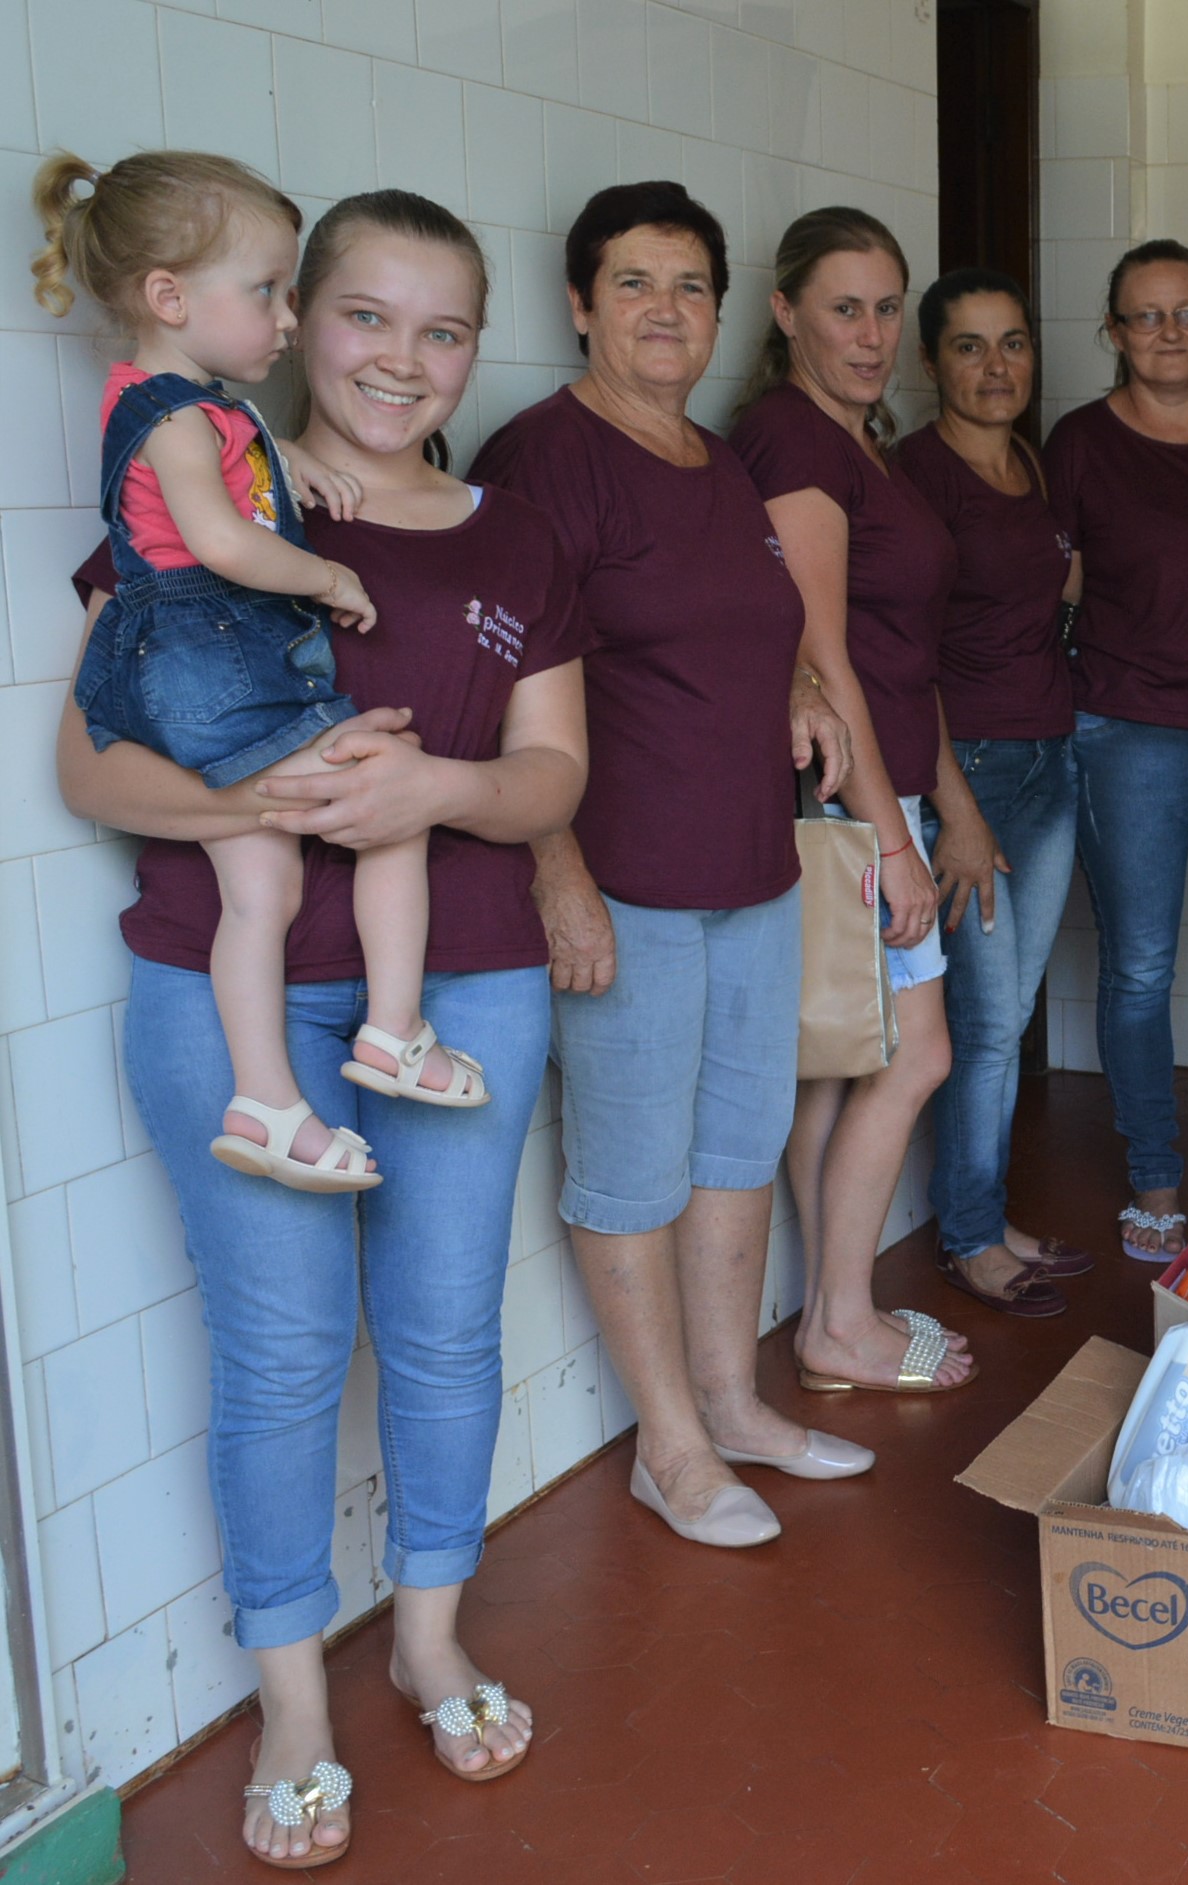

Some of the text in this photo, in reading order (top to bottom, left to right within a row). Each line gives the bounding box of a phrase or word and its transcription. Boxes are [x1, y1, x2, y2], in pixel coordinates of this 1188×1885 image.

[495, 604, 525, 634] Núcleo
[1051, 1525, 1104, 1540] MANTENHA
[1107, 1533, 1159, 1548] RESFRIADO
[1087, 1583, 1178, 1626] Becel
[1128, 1706, 1162, 1721] Creme
